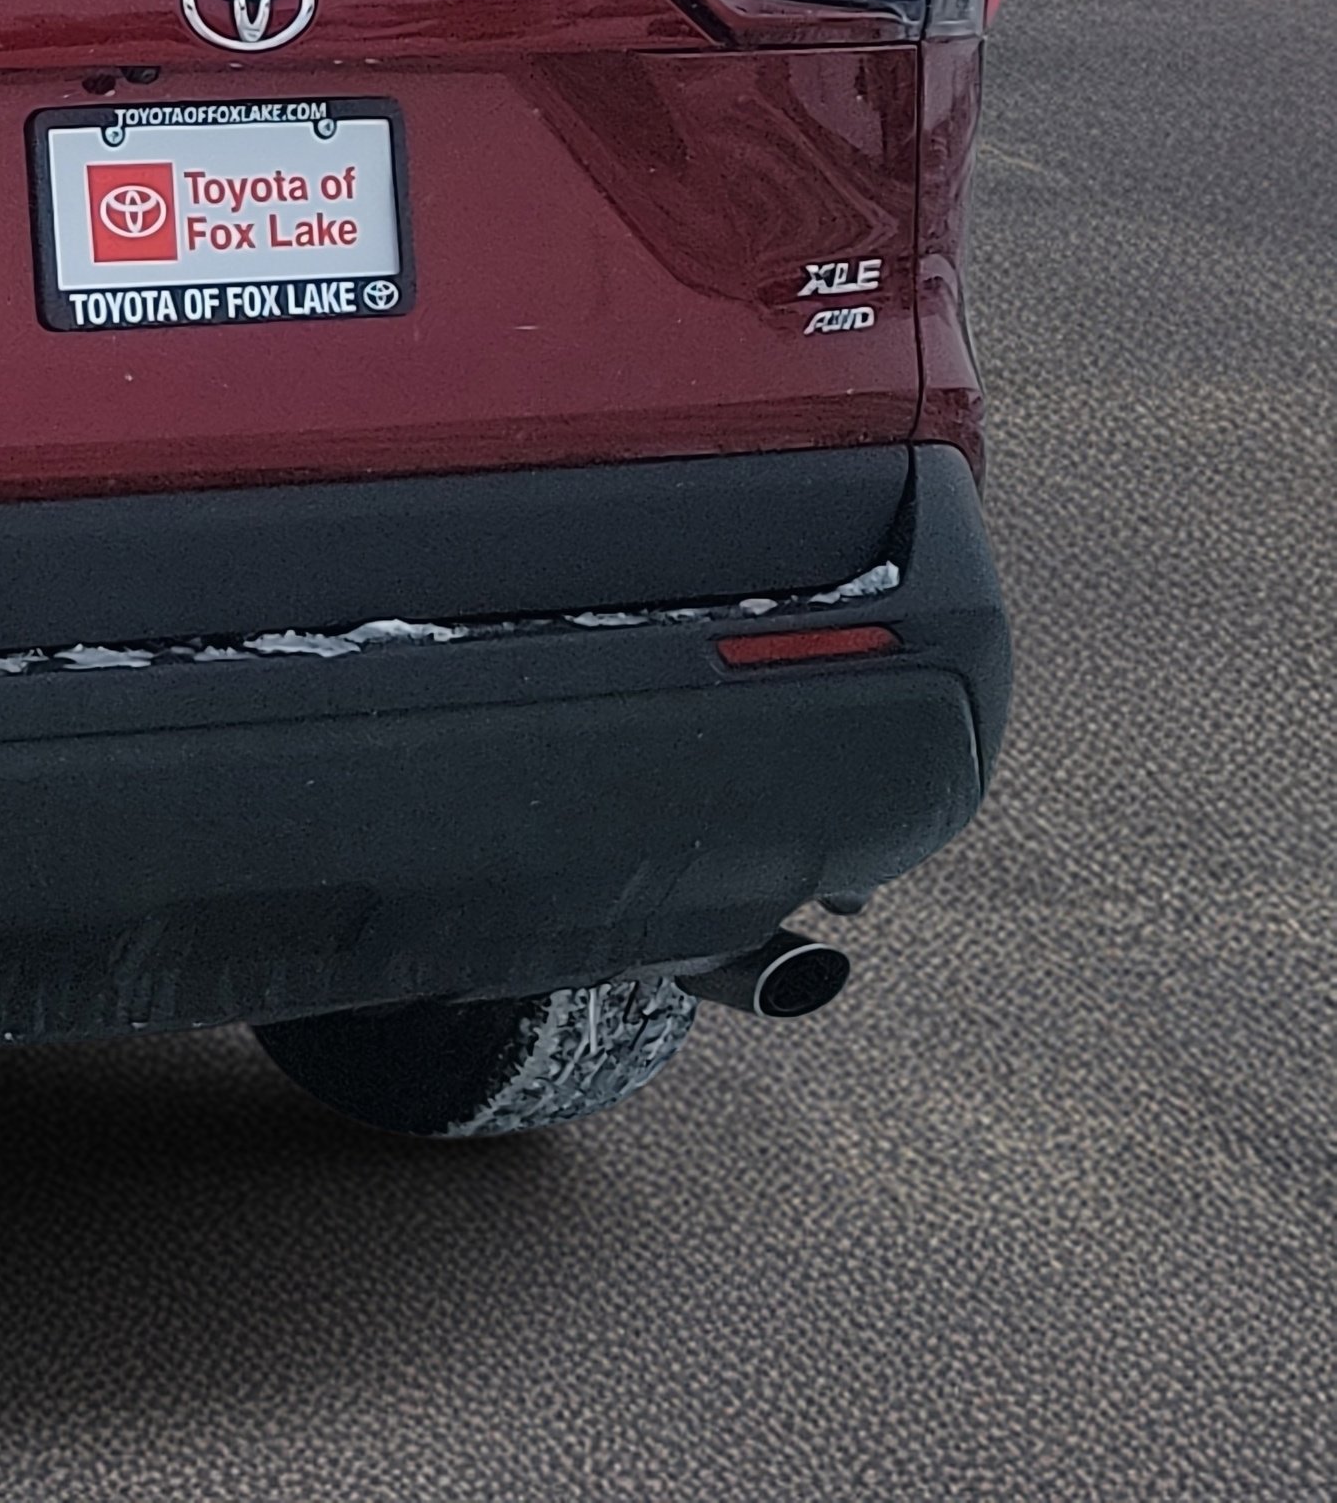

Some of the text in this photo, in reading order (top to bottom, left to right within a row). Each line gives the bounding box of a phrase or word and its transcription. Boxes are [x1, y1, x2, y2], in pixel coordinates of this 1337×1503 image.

[114, 102, 327, 128] TOYOTAOFFOXLAKE.COM
[184, 167, 356, 212] Toyota of
[187, 212, 358, 250] Fox Lake
[797, 259, 882, 296] XLE
[69, 281, 358, 325] TOYOTA OF FOX LAKE
[803, 306, 875, 335] AWD
